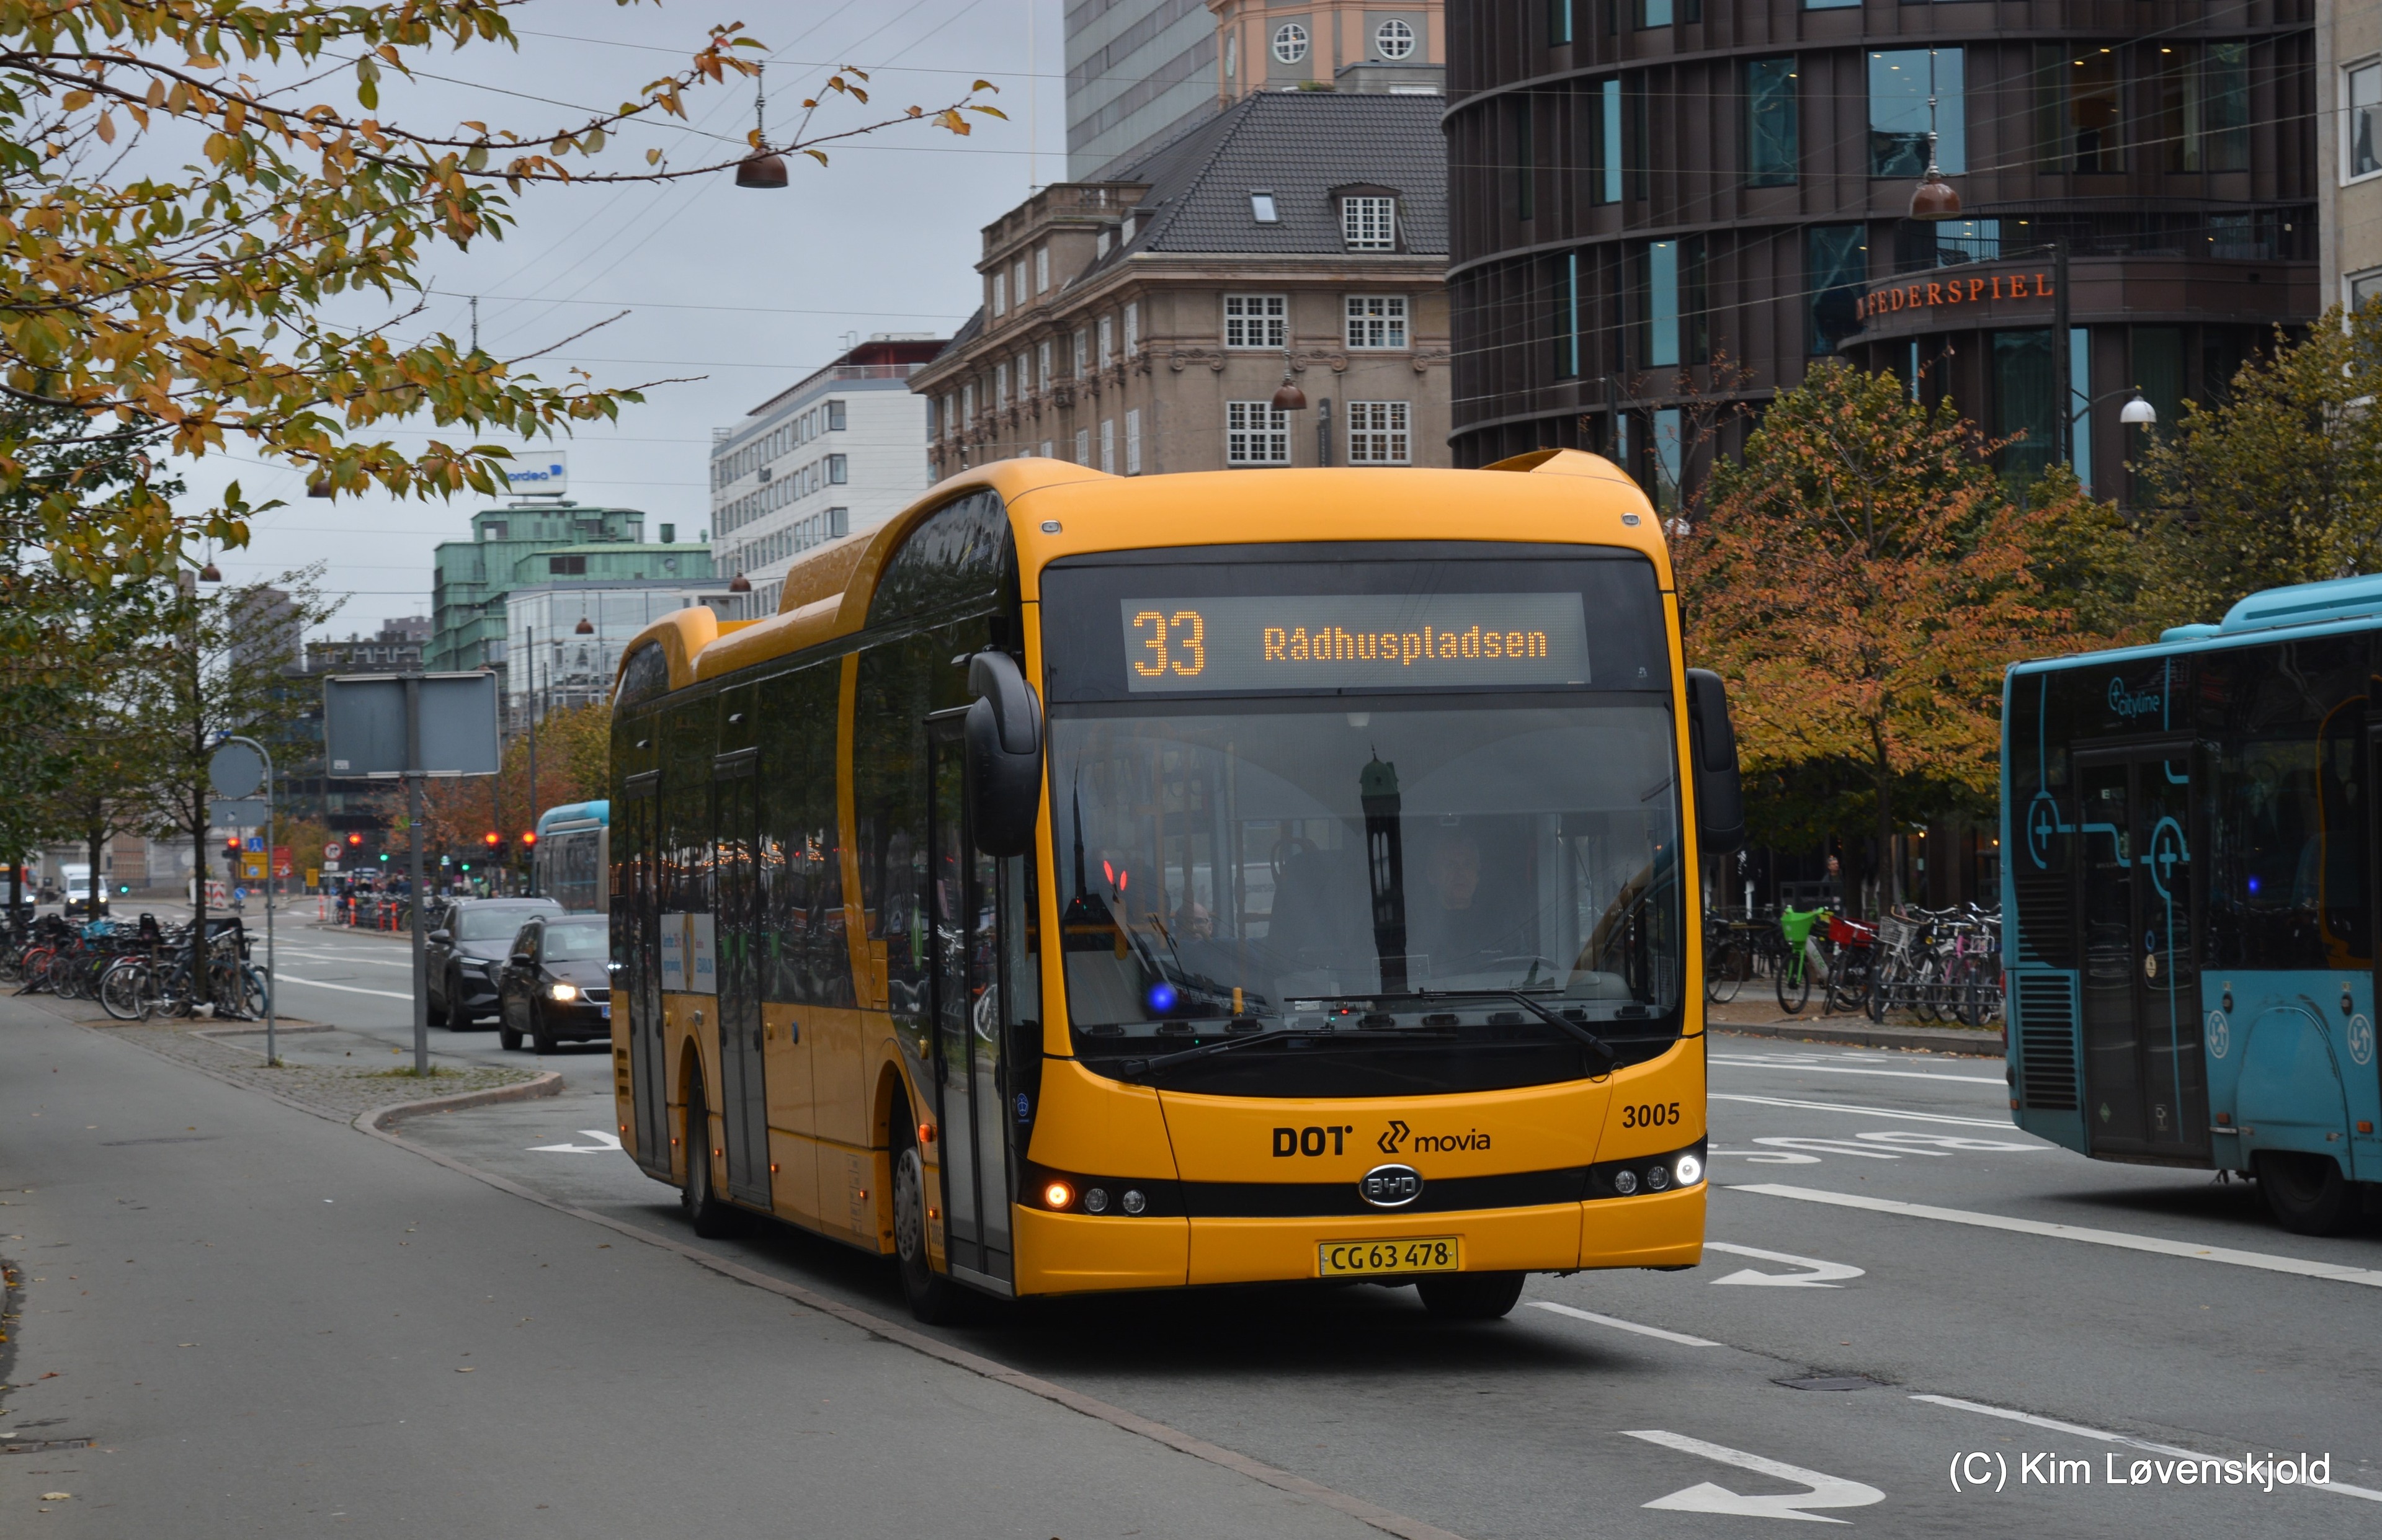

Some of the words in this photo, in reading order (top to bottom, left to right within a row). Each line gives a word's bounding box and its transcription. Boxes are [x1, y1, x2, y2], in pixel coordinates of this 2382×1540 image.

[1868, 274, 2054, 314] FEDERSPIEL
[507, 470, 549, 481] ordea
[1134, 611, 1205, 677] 33
[1264, 625, 1547, 665] Rådhuspladsen
[1622, 1102, 1680, 1129] 3005
[1272, 1125, 1354, 1157] DOT
[1414, 1128, 1491, 1153] movia
[1367, 1177, 1416, 1195] BYD
[1331, 1247, 1364, 1270] CG
[1369, 1245, 1398, 1268] 63
[1404, 1242, 1448, 1266] 478
